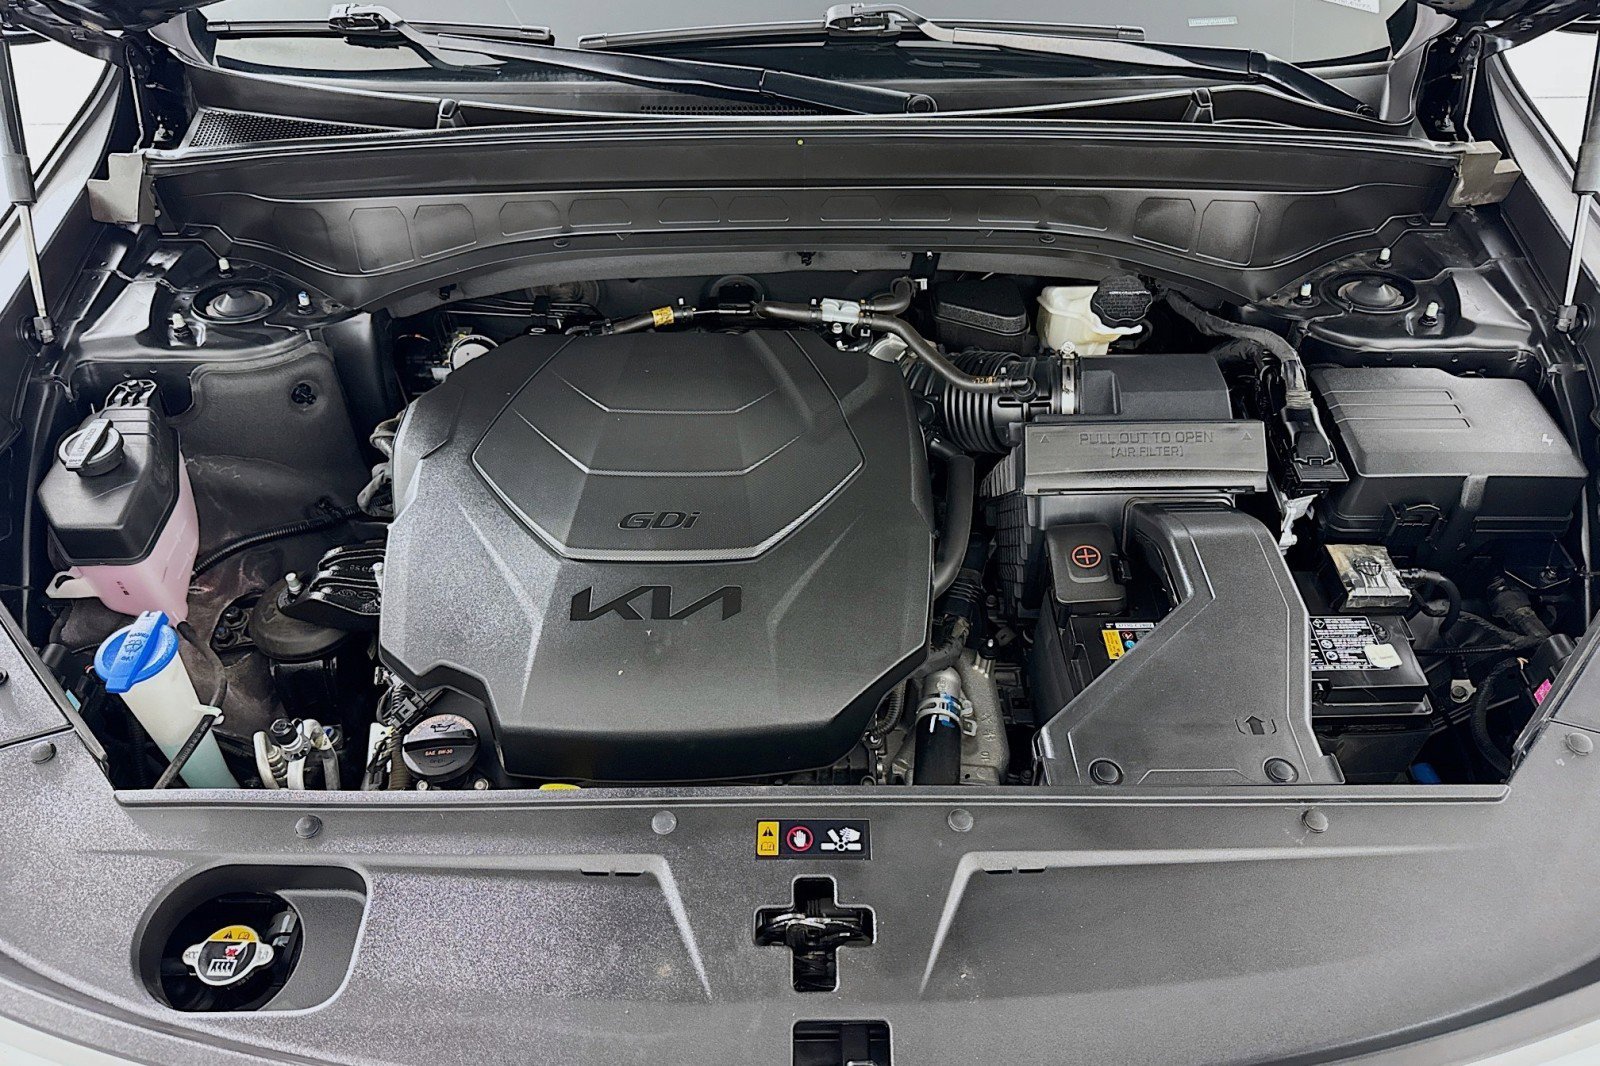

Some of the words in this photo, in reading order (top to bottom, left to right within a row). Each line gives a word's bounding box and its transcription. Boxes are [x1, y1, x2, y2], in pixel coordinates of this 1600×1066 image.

[1079, 432, 1116, 445] PULL
[1119, 432, 1148, 444] OUT
[1151, 431, 1171, 443] TO
[1175, 431, 1213, 443] OPEN
[617, 511, 701, 530] GDi
[570, 585, 742, 621] KIA
